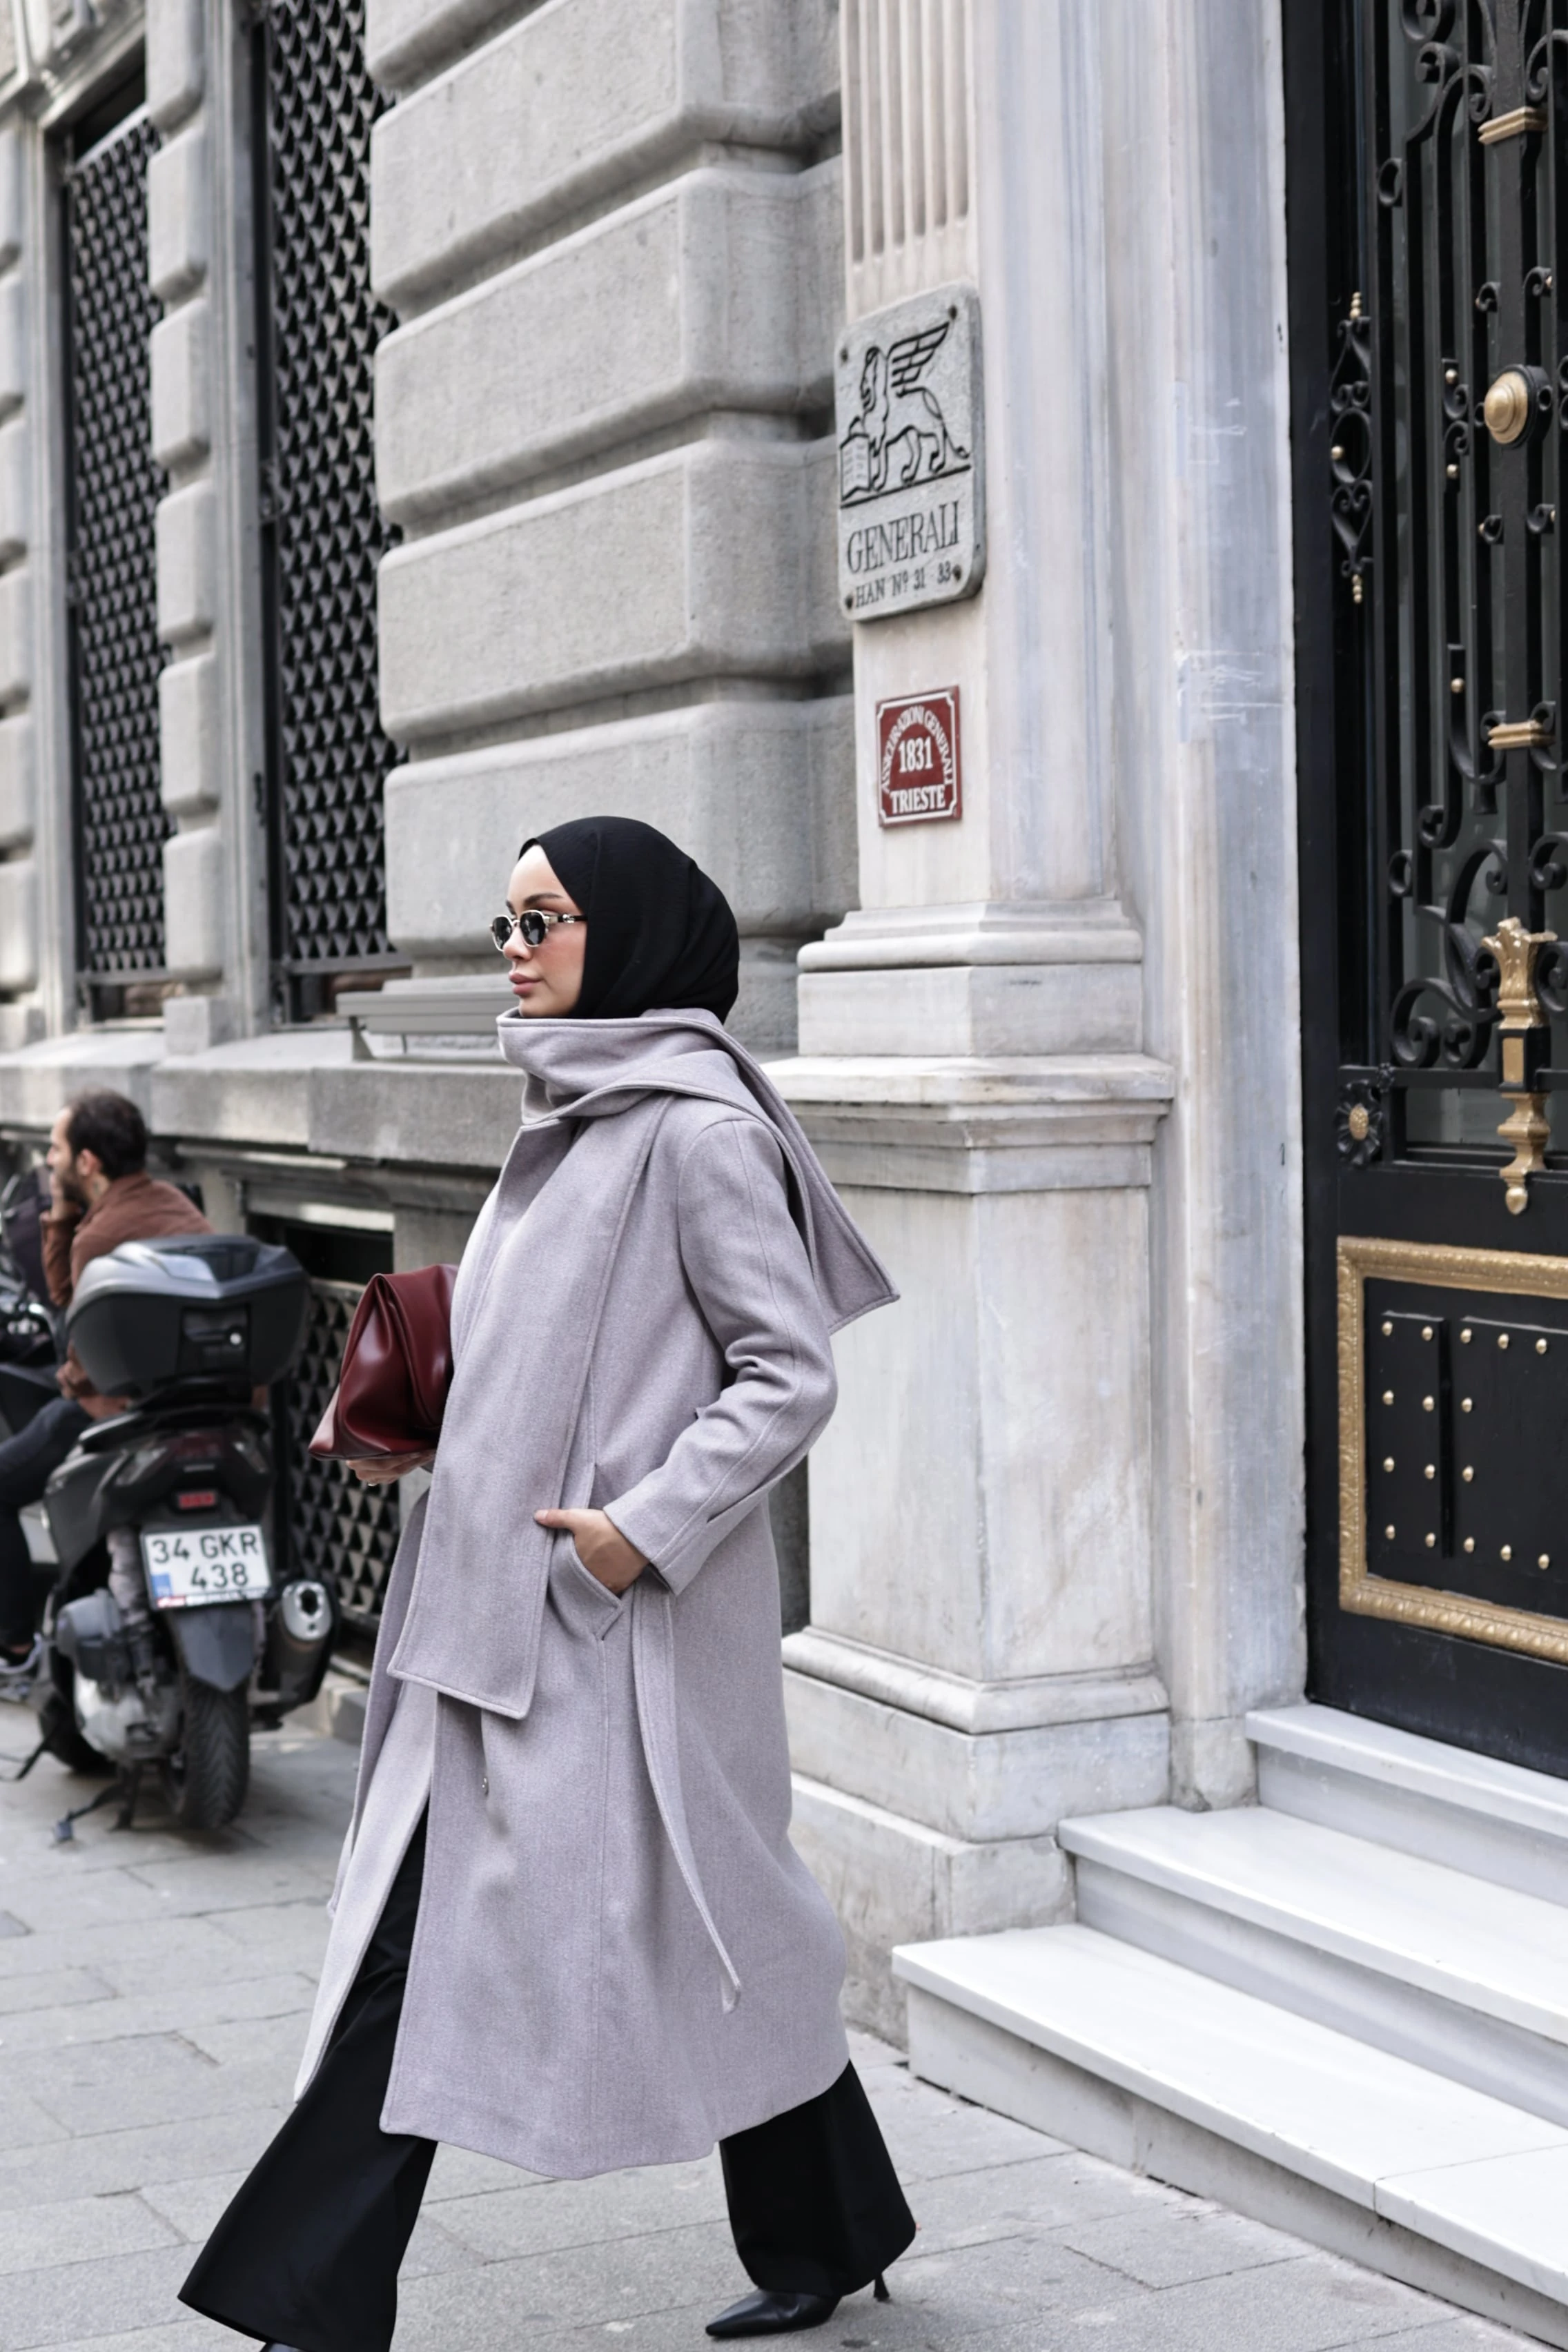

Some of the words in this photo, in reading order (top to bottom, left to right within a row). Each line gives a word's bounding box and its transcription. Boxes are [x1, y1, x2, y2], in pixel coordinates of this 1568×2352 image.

[847, 500, 959, 574] GENERALI
[855, 577, 886, 608] HAN
[913, 567, 927, 590] 31
[937, 560, 952, 585] 33
[899, 736, 933, 774] 1831
[923, 709, 953, 785] GENERALI
[890, 783, 946, 815] TRIESTE
[151, 1538, 190, 1564] 34
[199, 1531, 259, 1558] GKR
[190, 1562, 248, 1589] 438
